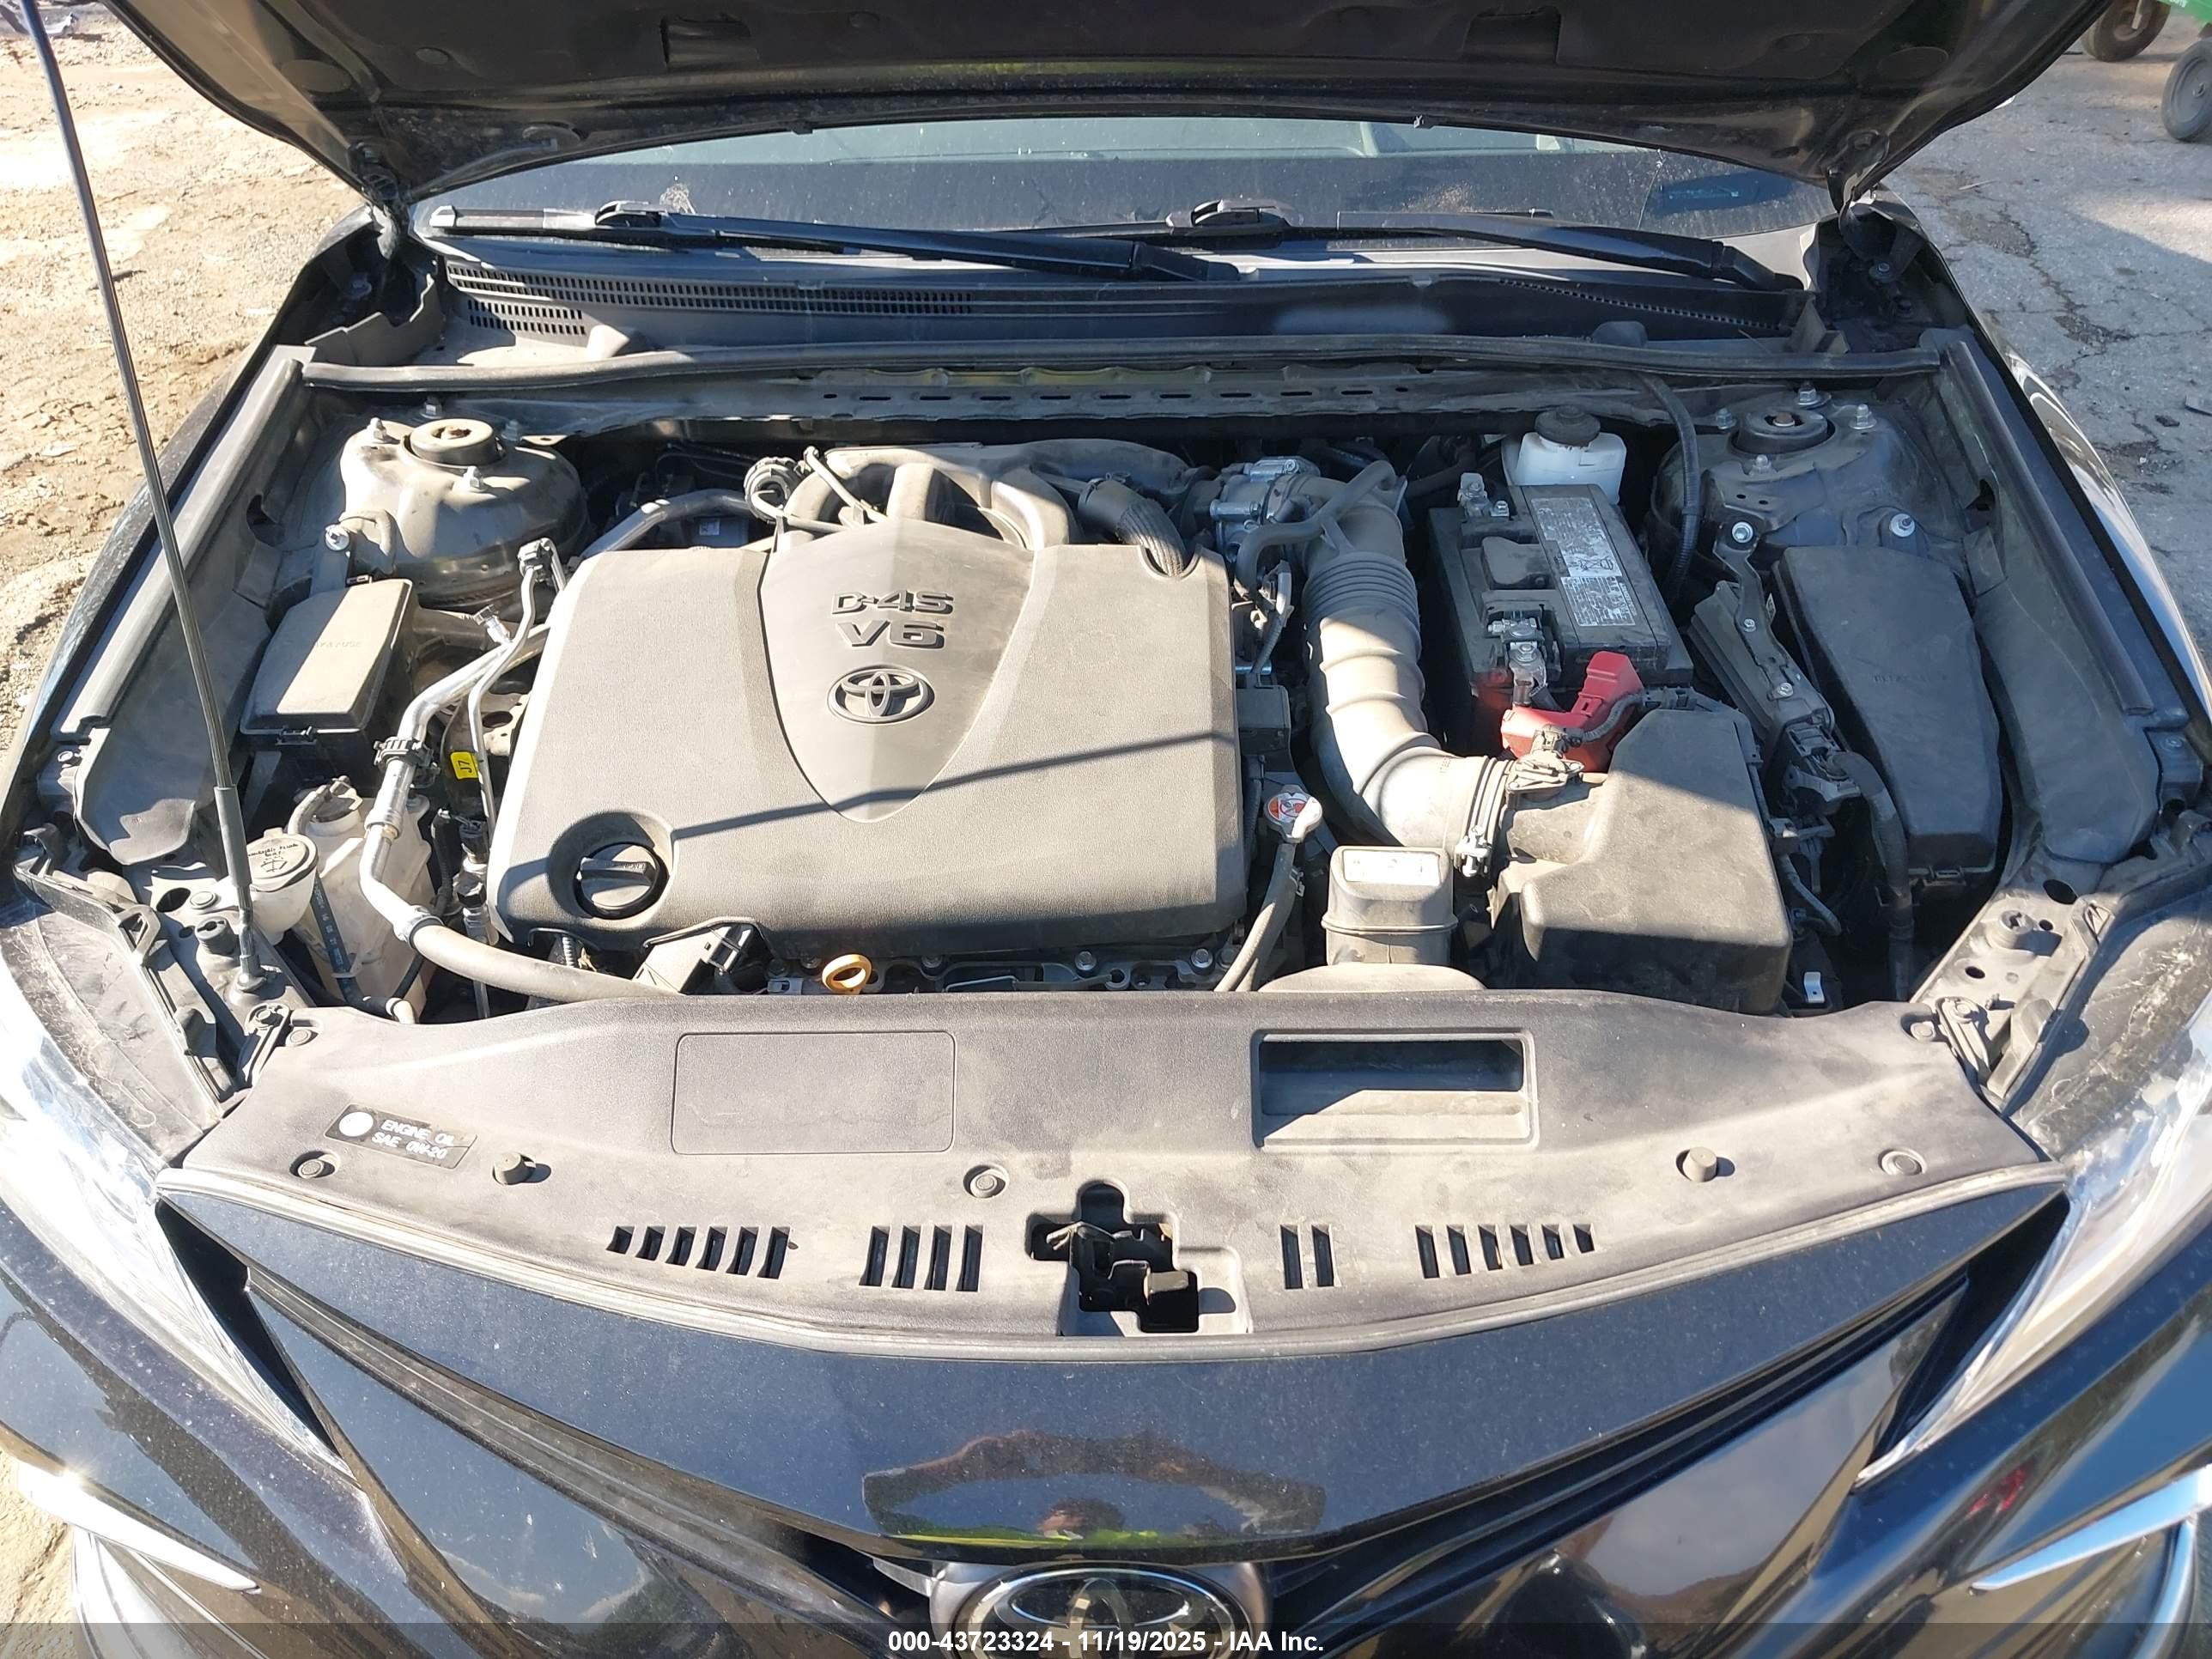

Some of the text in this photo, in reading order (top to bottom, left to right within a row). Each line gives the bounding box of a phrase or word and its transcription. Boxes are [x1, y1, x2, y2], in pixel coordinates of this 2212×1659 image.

[832, 590, 954, 615] D-4S
[837, 619, 945, 649] V6
[371, 1131, 448, 1160] SAE 0W-20
[380, 1119, 455, 1146] ENGINE OIL
